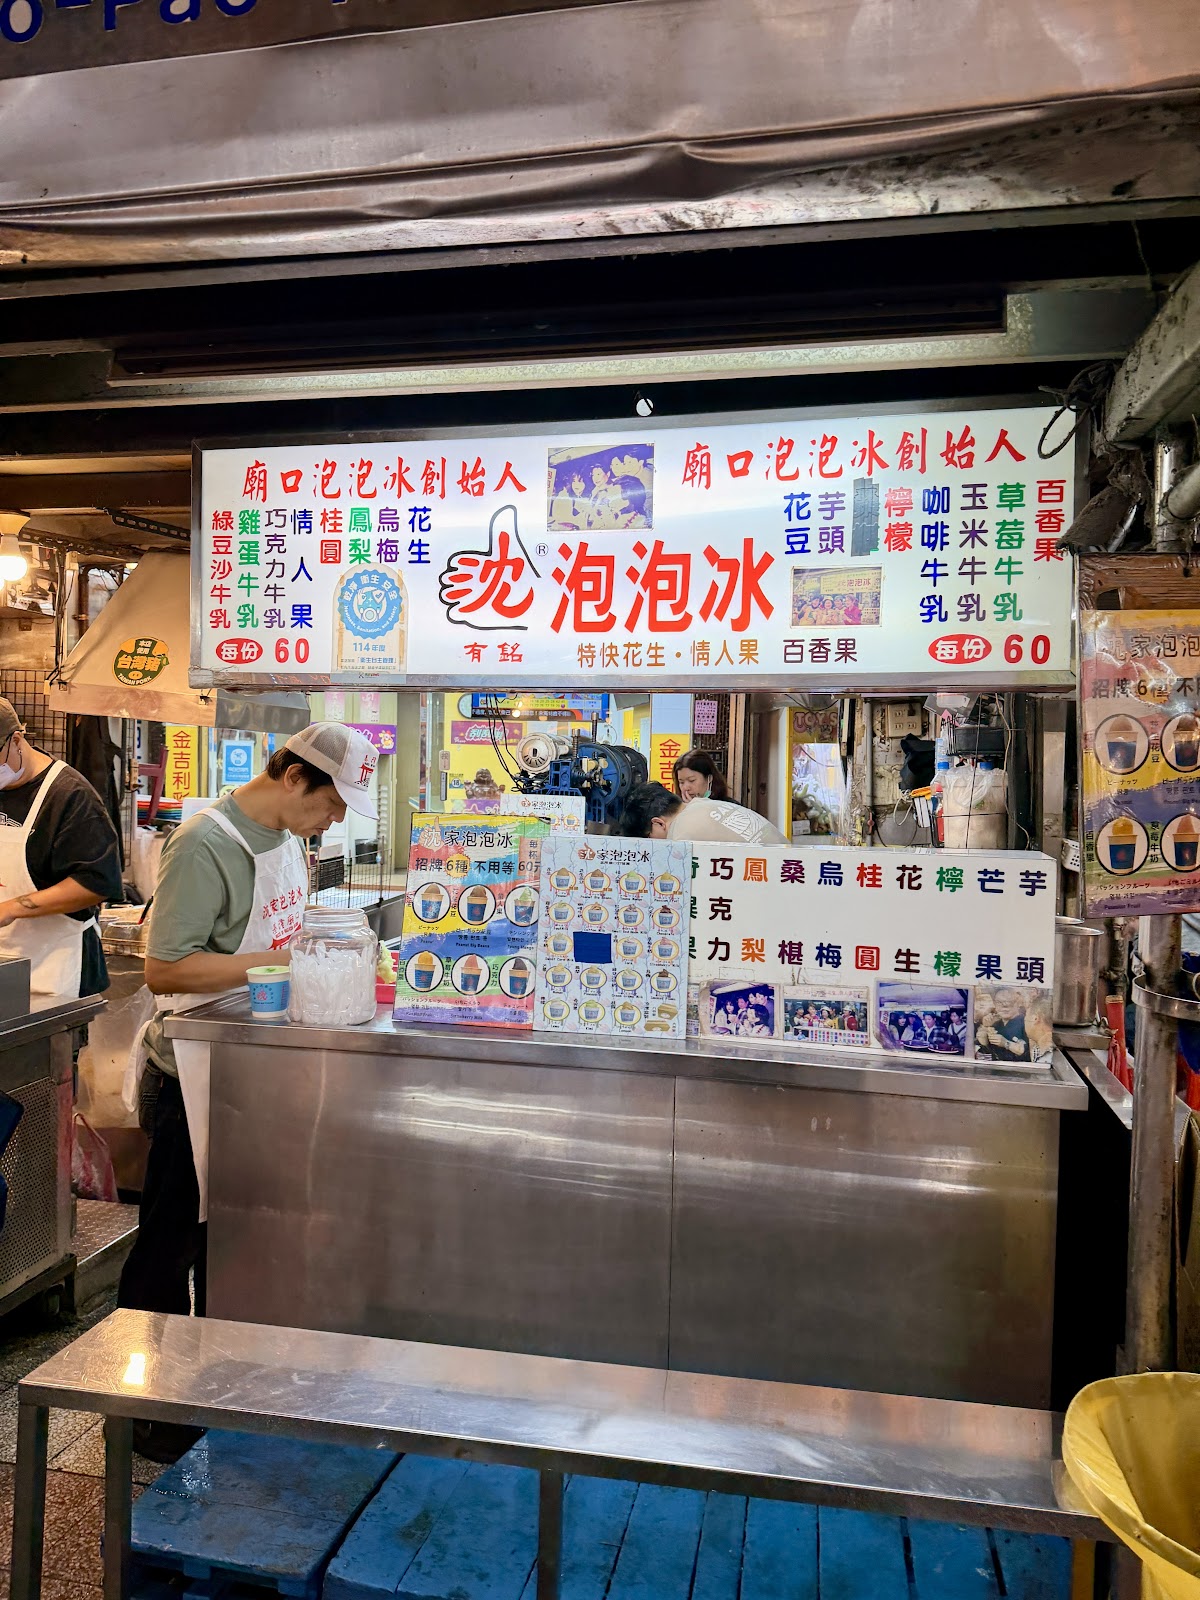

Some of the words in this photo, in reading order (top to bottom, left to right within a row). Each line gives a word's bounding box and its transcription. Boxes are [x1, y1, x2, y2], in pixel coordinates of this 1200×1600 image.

[242, 456, 528, 503] 廟口泡泡冰創始人
[682, 424, 1026, 490] 廟口泡泡冰創始人
[320, 508, 343, 564] 桂圓
[349, 507, 372, 564] 鳳梨
[376, 506, 400, 564] 烏梅
[408, 506, 432, 564] 花生
[783, 492, 811, 555] 花豆
[817, 491, 846, 556] 芋頭
[884, 486, 914, 553] 檸檬
[993, 481, 1026, 622] 草莓牛乳
[1033, 479, 1067, 564] 百香果
[209, 510, 234, 629] 綠豆沙牛乳
[237, 509, 261, 629] 雞蛋牛乳
[263, 508, 287, 630] 巧克力牛乳
[290, 508, 314, 630] 情人果
[550, 537, 775, 634] 泡泡冰
[919, 486, 950, 624] 咖啡牛乳
[956, 483, 989, 624] 玉米牛乳
[219, 642, 260, 661] 每份
[273, 637, 310, 664] 60
[463, 642, 523, 663] 有銘
[783, 637, 858, 664] 百香果
[933, 638, 988, 662] 每份
[1003, 634, 1051, 665] 60
[423, 829, 513, 849] 沈家泡泡冰
[474, 860, 515, 875] 不用等
[708, 857, 734, 962] 巧克力
